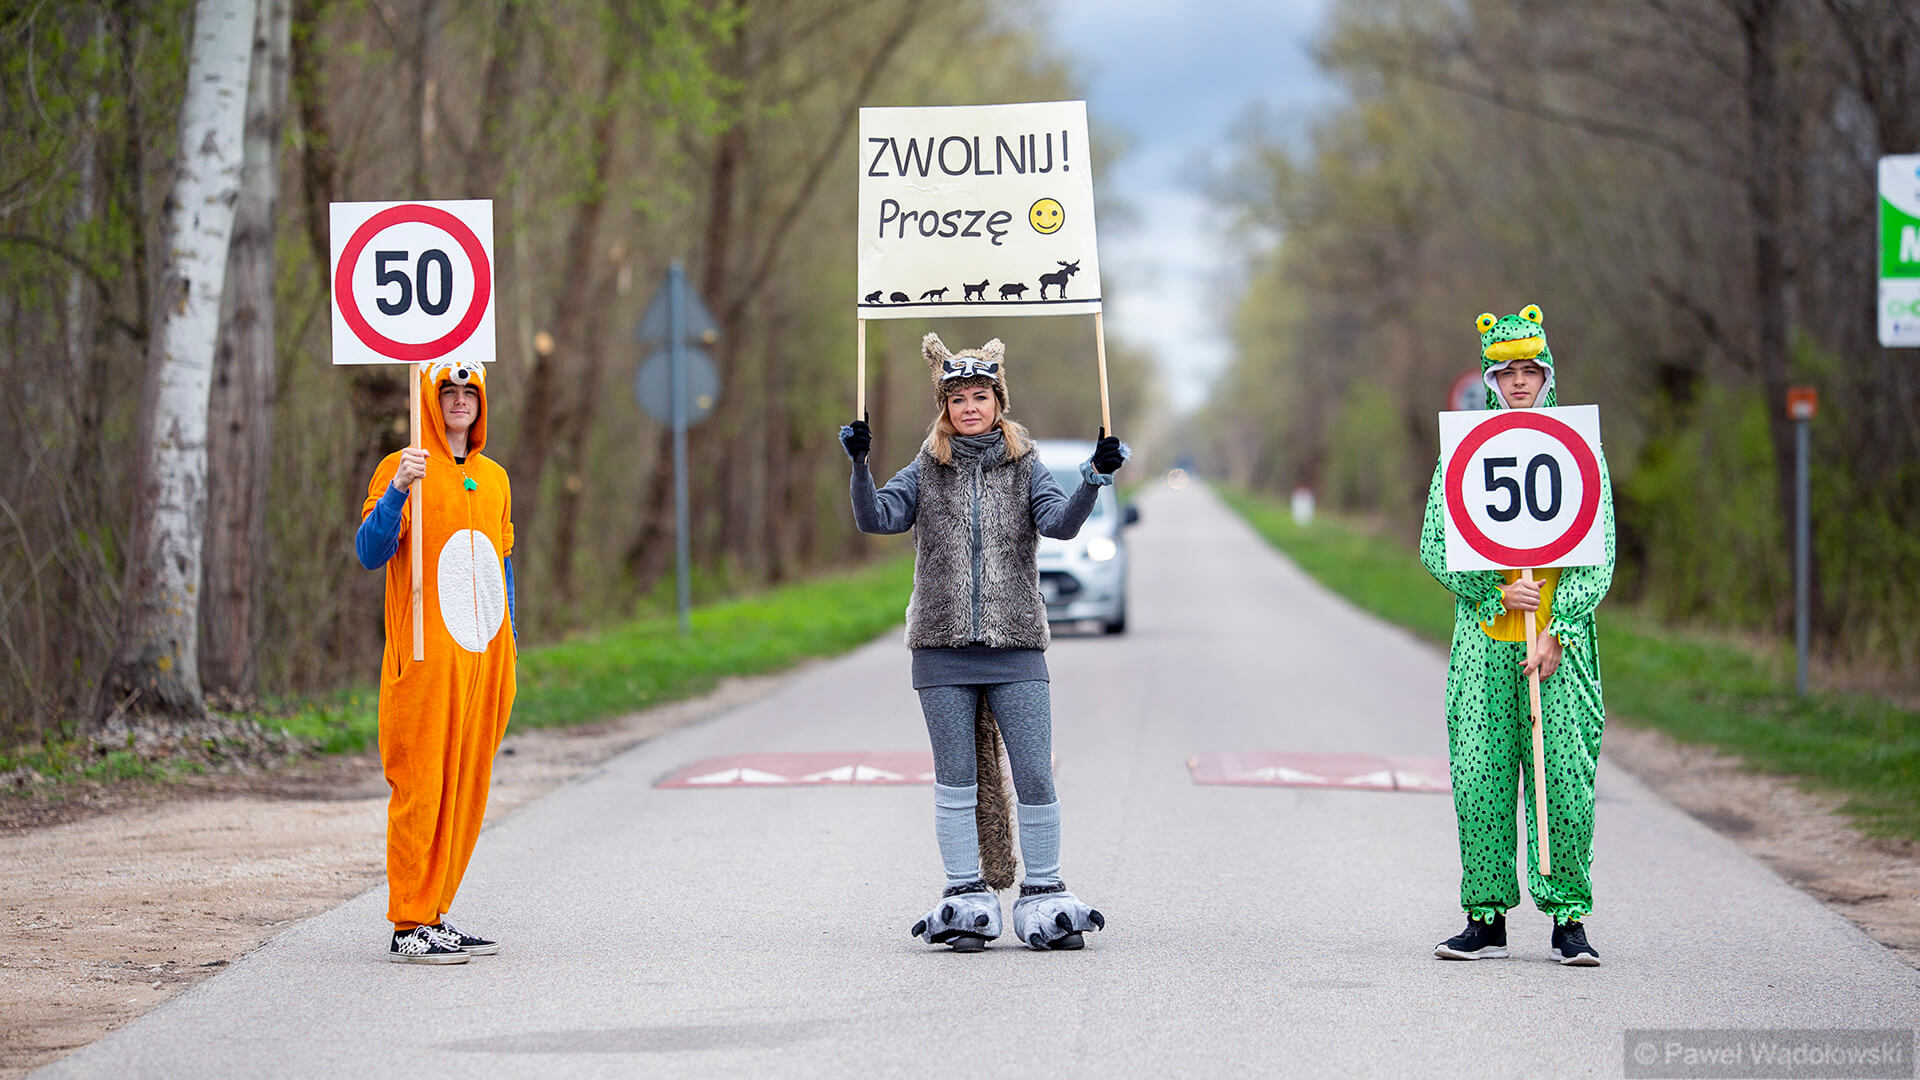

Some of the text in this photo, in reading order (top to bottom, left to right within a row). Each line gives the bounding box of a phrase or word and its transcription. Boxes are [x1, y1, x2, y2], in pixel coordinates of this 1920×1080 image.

[868, 130, 1070, 177] ZWOLNIJ!
[878, 198, 1013, 246] Proszę
[375, 248, 453, 316] 50
[1483, 453, 1562, 523] 50
